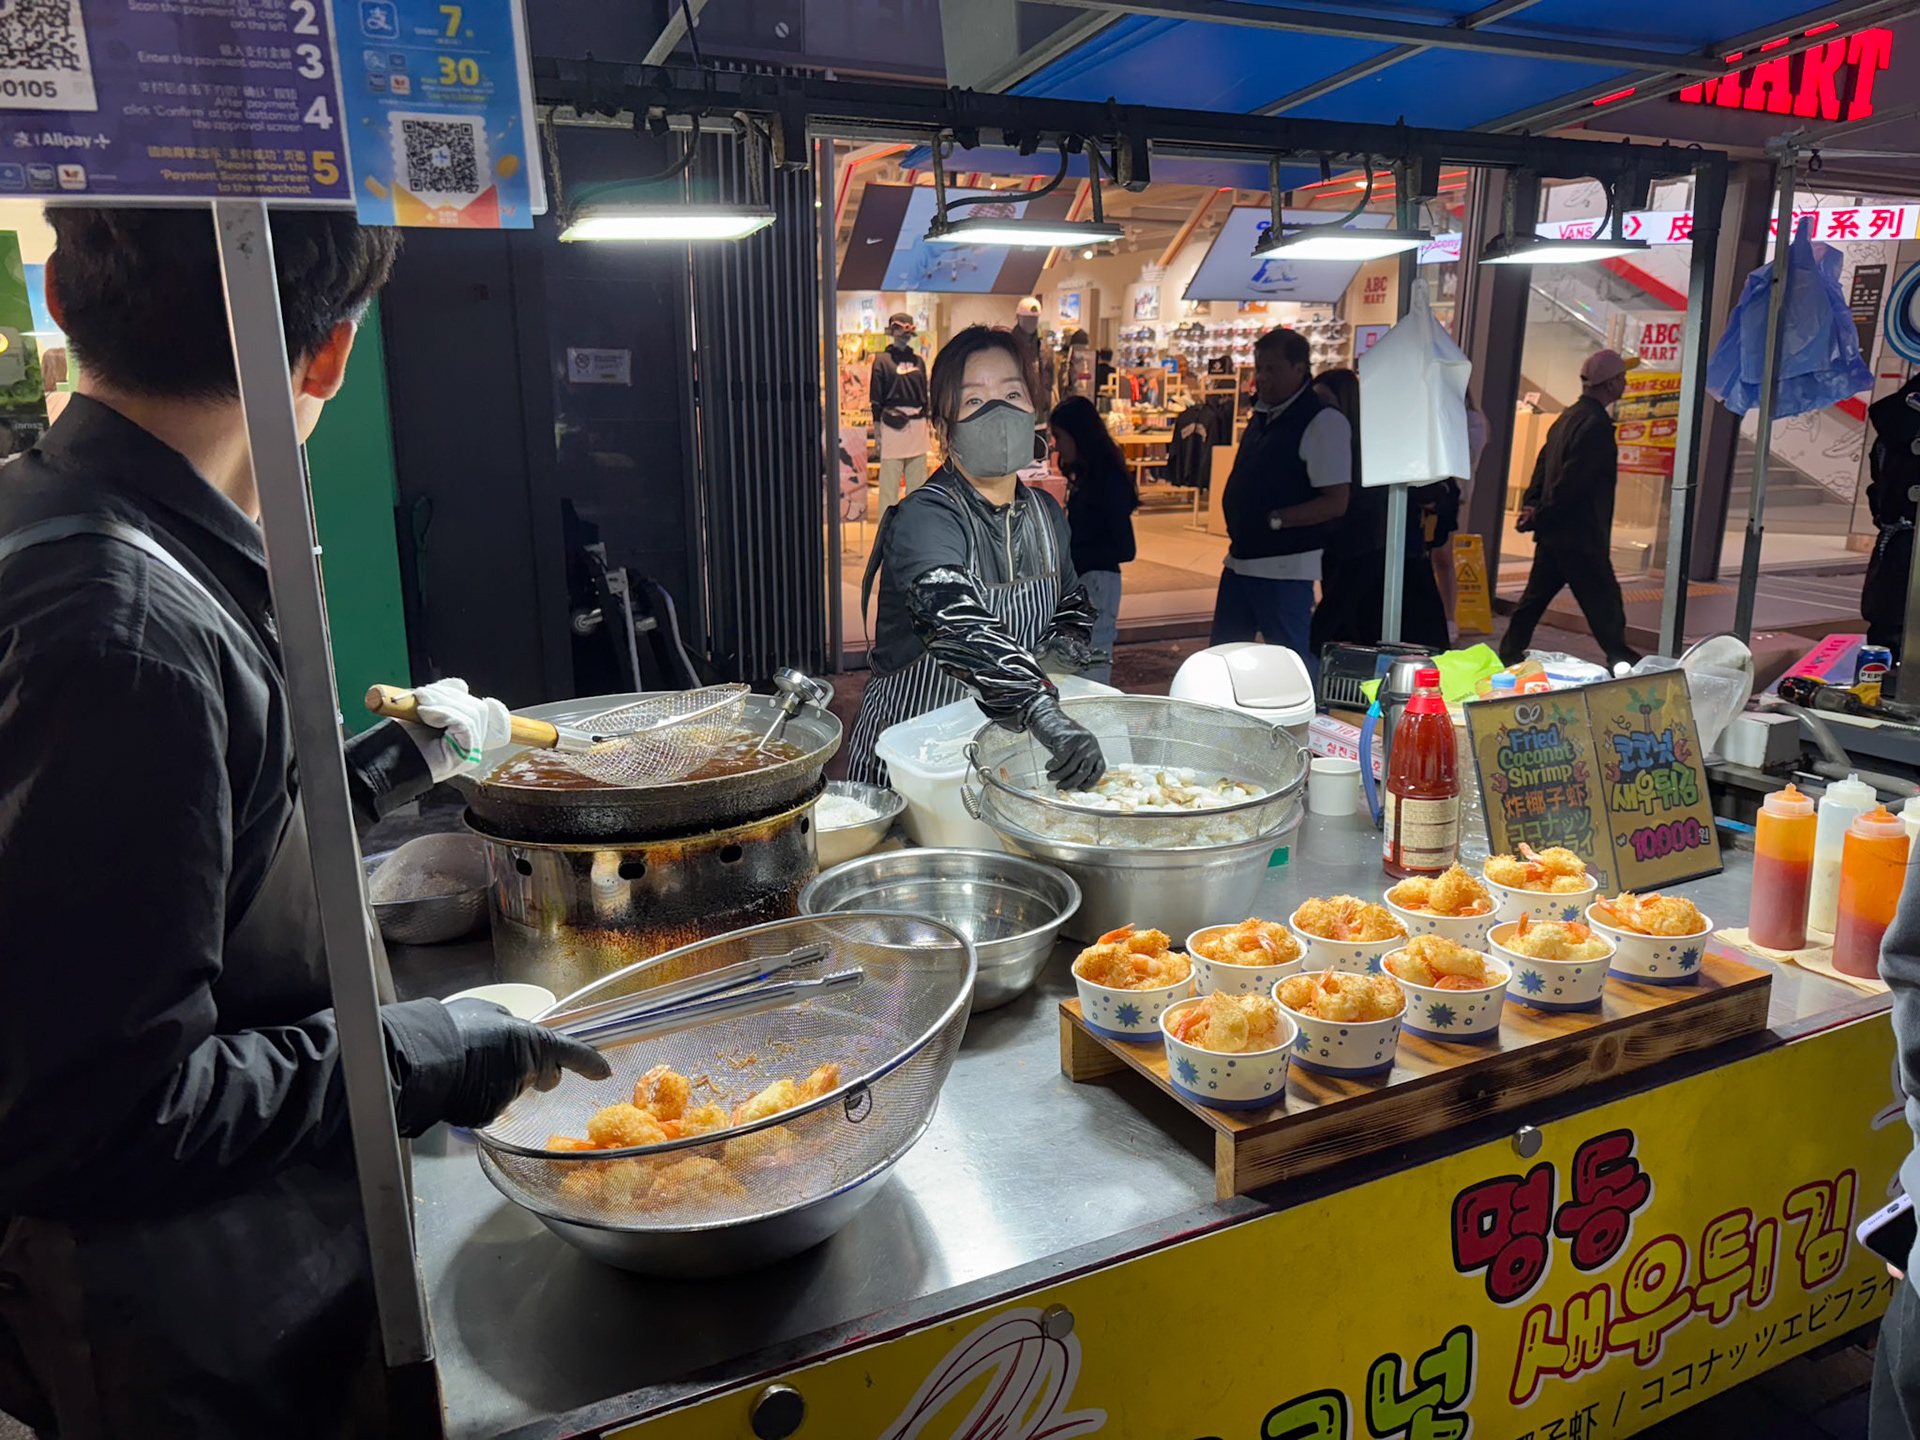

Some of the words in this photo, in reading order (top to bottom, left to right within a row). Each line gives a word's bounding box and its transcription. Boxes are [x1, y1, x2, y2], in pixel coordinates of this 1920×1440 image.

[230, 20, 246, 29] on
[248, 21, 266, 31] the
[268, 21, 288, 32] left
[289, 0, 320, 35] 2
[439, 4, 462, 37] 7
[137, 51, 170, 63] Enter
[173, 52, 192, 65] the
[194, 54, 247, 68] payment
[248, 59, 292, 70] amount
[295, 43, 325, 79] 3
[438, 56, 480, 86] 30
[1679, 22, 1894, 121] MART
[0, 79, 58, 98] 0105
[214, 97, 243, 108] After
[223, 107, 242, 119] the
[245, 108, 287, 120] bottom
[288, 110, 300, 121] of
[303, 96, 334, 130] 4
[192, 118, 212, 129] the
[213, 121, 265, 133] approval
[266, 123, 302, 133] screen
[215, 159, 254, 171] Please
[256, 161, 287, 172] show
[288, 162, 308, 173] the
[272, 174, 311, 183] screen
[313, 151, 340, 185] 5
[217, 183, 231, 192] to
[233, 183, 253, 193] the
[255, 184, 312, 195] merchant
[1558, 222, 1594, 240] VANS
[1364, 276, 1388, 293] ABC
[1363, 293, 1386, 304] MART
[1640, 323, 1680, 345] ABC
[1639, 346, 1677, 361] MART
[1508, 726, 1559, 752] Fried
[1612, 729, 1676, 771] 코코넛
[1499, 742, 1574, 769] Coconut
[1508, 764, 1573, 788] Shrimp
[1612, 761, 1699, 815] 새우튀김
[1504, 783, 1586, 818] 炸椰子虾
[1507, 808, 1590, 842] ココナッツ
[1451, 1128, 1652, 1304] 명동
[1509, 1168, 1857, 1406] 새우튀김
